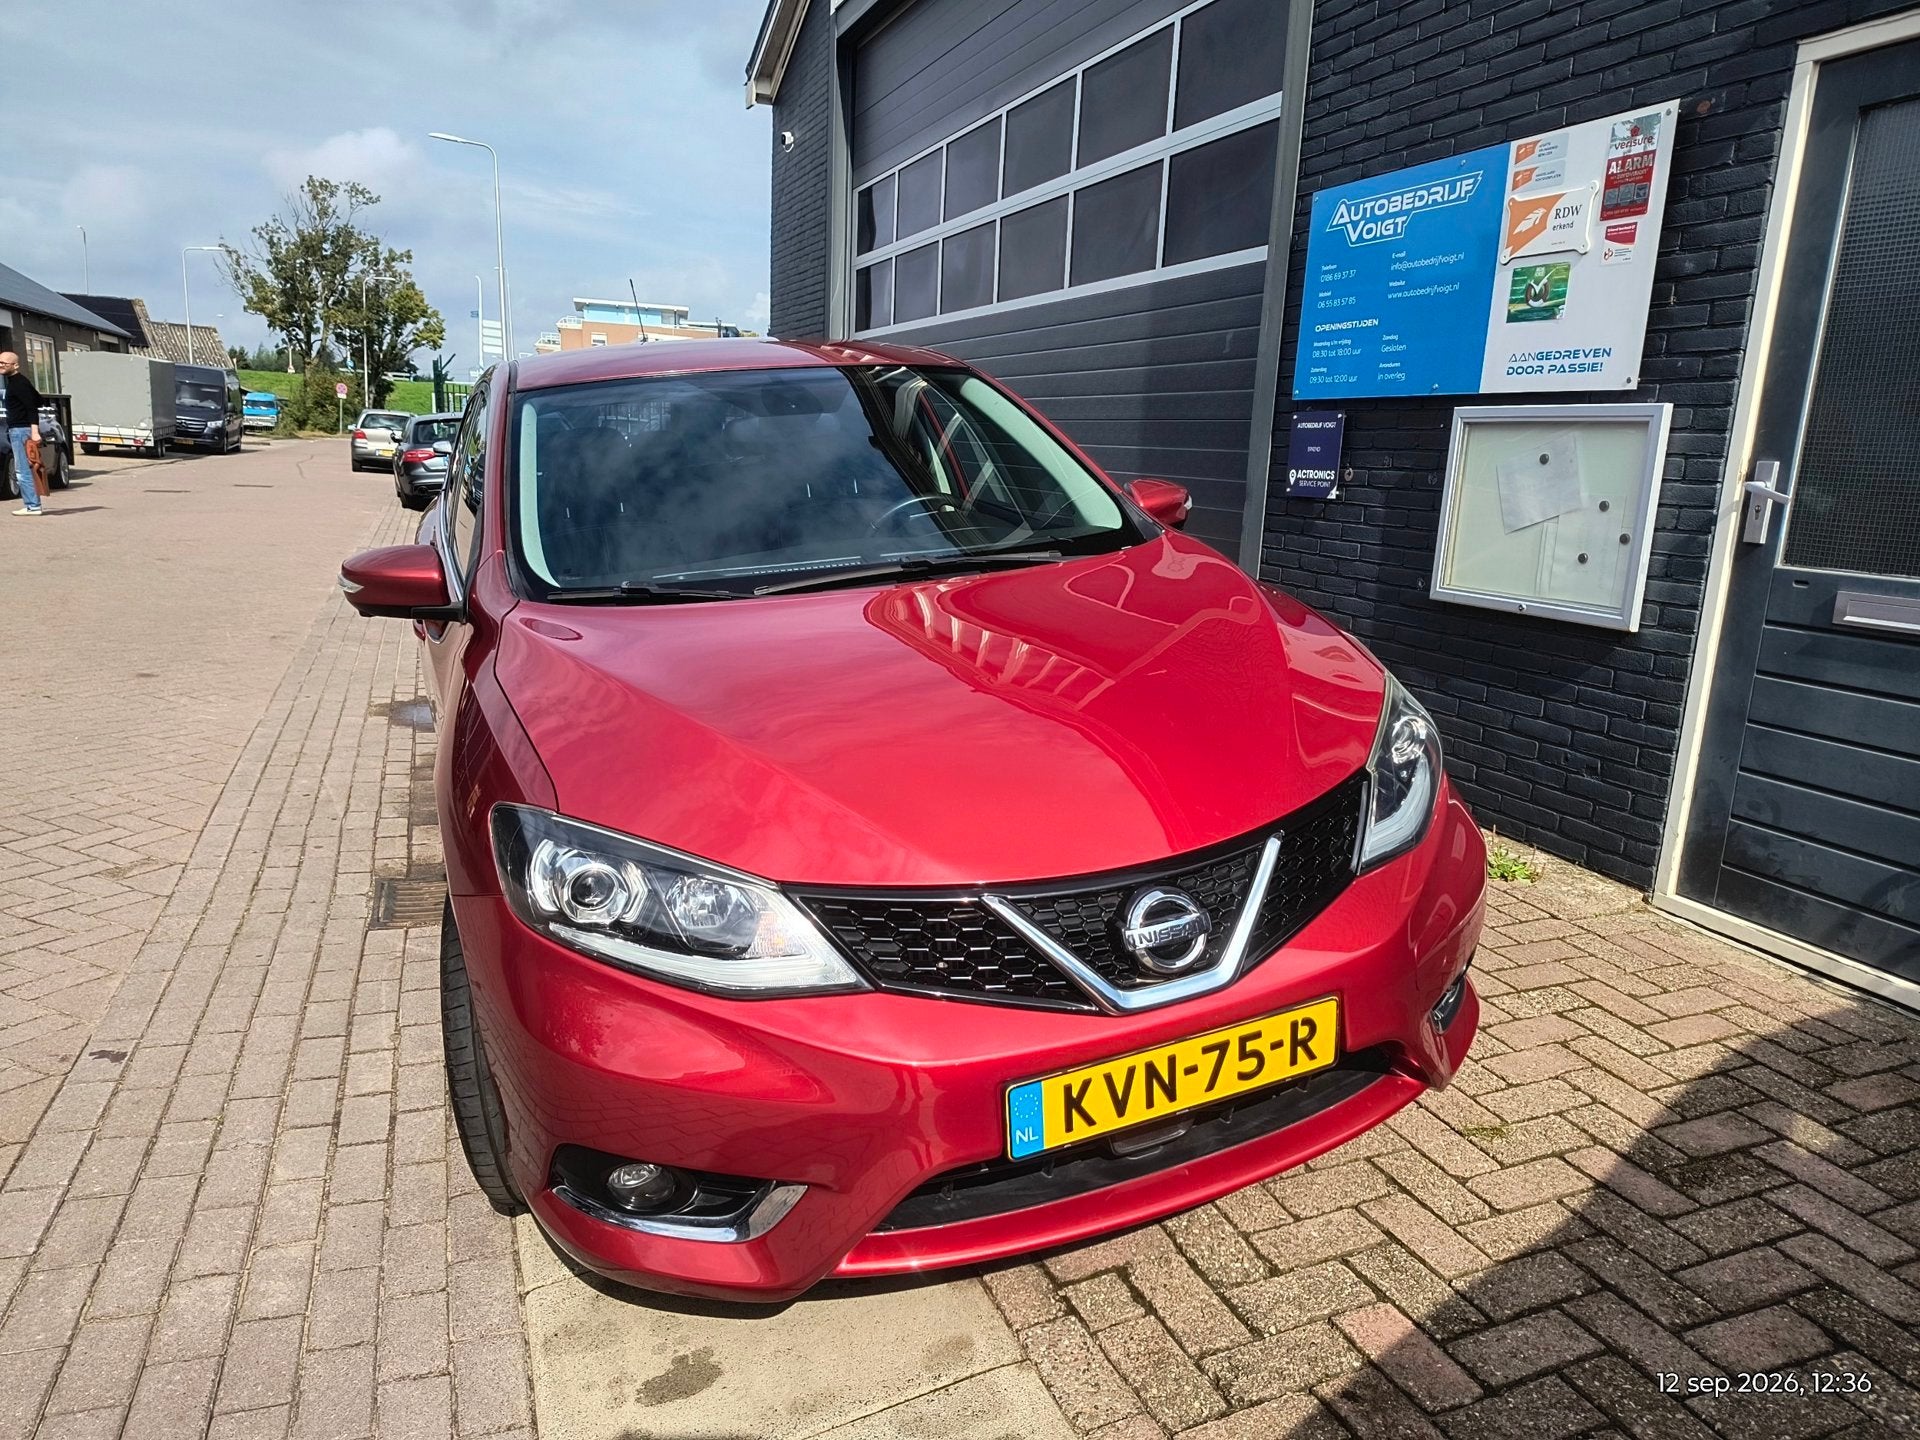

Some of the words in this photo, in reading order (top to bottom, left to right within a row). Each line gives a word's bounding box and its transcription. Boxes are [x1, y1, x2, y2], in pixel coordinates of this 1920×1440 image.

[1614, 135, 1655, 150] verisure
[1608, 153, 1653, 174] ALARM
[1332, 178, 1475, 226] AUTOBEDRIJF
[1554, 204, 1582, 219] RDW
[1346, 216, 1409, 242] VOIGT
[1552, 221, 1574, 231] erkend
[1390, 252, 1465, 271] info@autobedrijfvoigt.nl
[1333, 272, 1341, 280] 69
[1342, 270, 1349, 279] 37
[1349, 269, 1356, 277] 37
[1387, 282, 1460, 299] www.autobedrijfvoigt.nl
[1315, 318, 1379, 332] OPENINGSTIJDEN
[1381, 344, 1407, 352] Gesloten
[1508, 347, 1612, 362] AANGEDREVEN
[1384, 371, 1406, 381] overleg
[1506, 365, 1545, 375] DOOR
[1547, 362, 1604, 374] PASSIE!
[1297, 469, 1335, 480] ACTRONICS
[1063, 1016, 1318, 1134] KVN-75-R
[1015, 1129, 1039, 1145] NL
